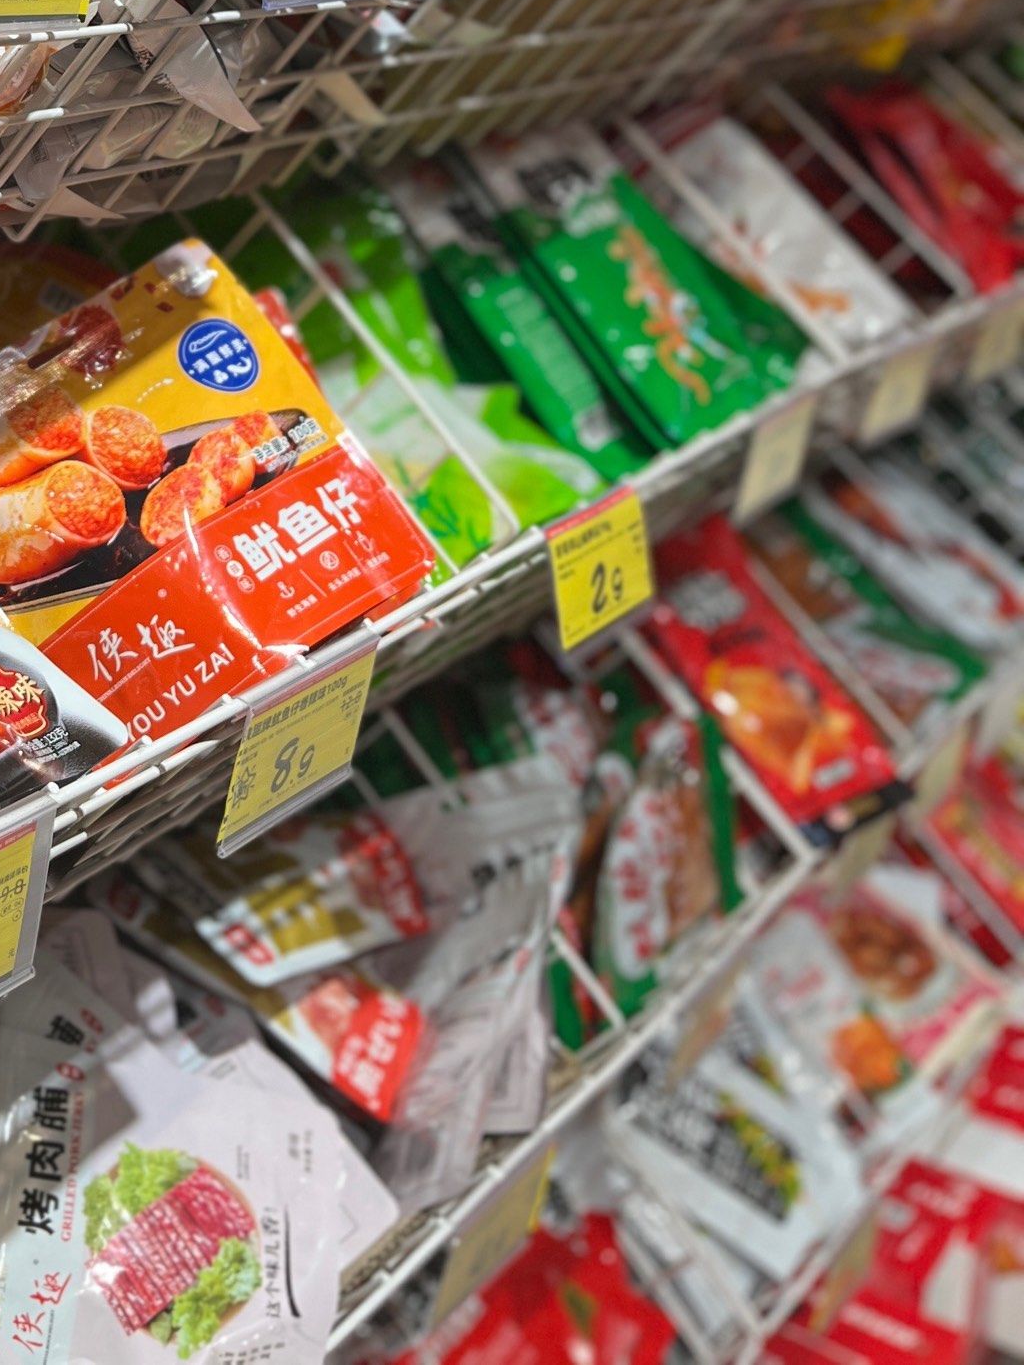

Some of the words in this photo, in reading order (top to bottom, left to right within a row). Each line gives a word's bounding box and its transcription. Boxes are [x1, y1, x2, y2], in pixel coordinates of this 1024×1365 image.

[232, 478, 362, 582] 鱿鱼仔
[163, 676, 197, 709] YU
[194, 642, 236, 683] ZAI
[271, 736, 316, 793] 8.9
[17, 1086, 69, 1237] 烤肉脯
[61, 1178, 77, 1242] GRILLED
